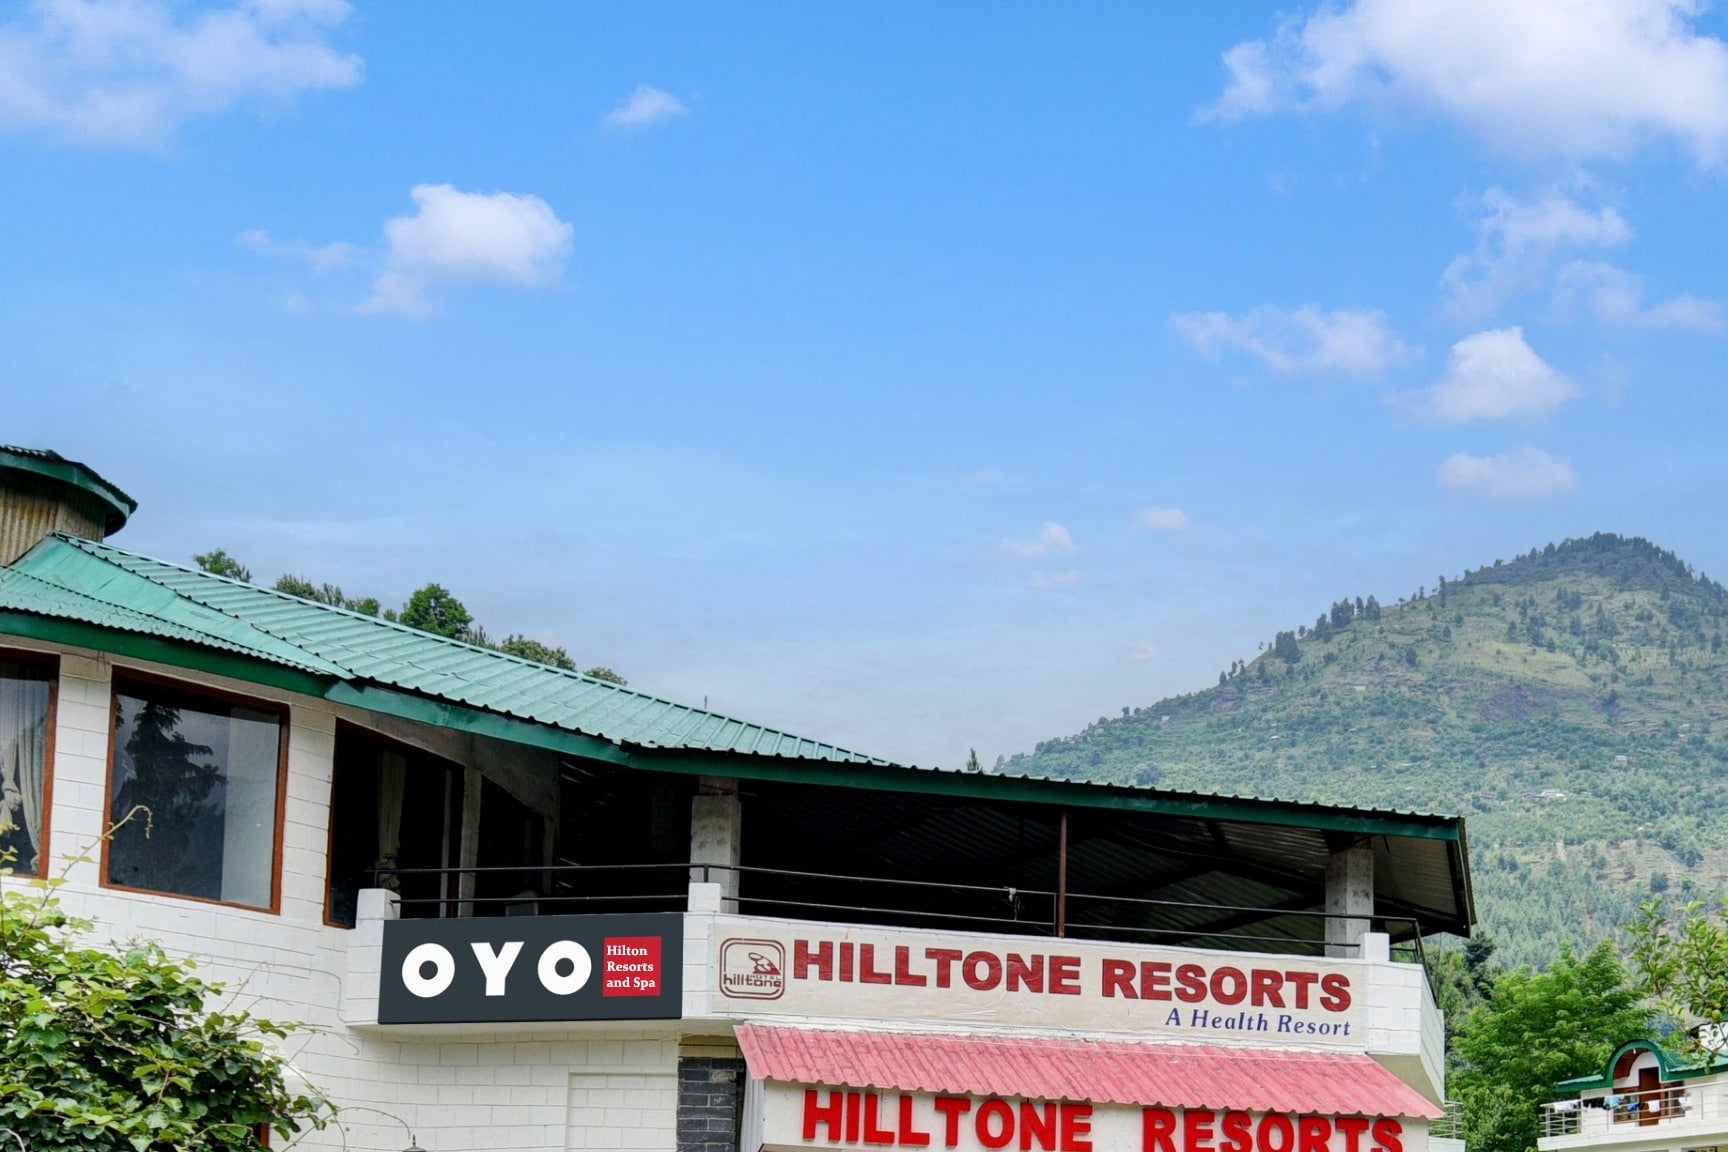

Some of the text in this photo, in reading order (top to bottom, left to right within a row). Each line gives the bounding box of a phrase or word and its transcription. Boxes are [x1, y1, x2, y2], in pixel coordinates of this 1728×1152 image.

[606, 944, 648, 956] Hilton
[401, 940, 592, 998] OYO
[606, 960, 654, 972] Resorts
[606, 976, 656, 991] and Spa
[723, 973, 782, 988] hilltone
[793, 939, 1352, 1013] HILLTONE RESORTS
[1165, 1007, 1352, 1037] A Health Resort
